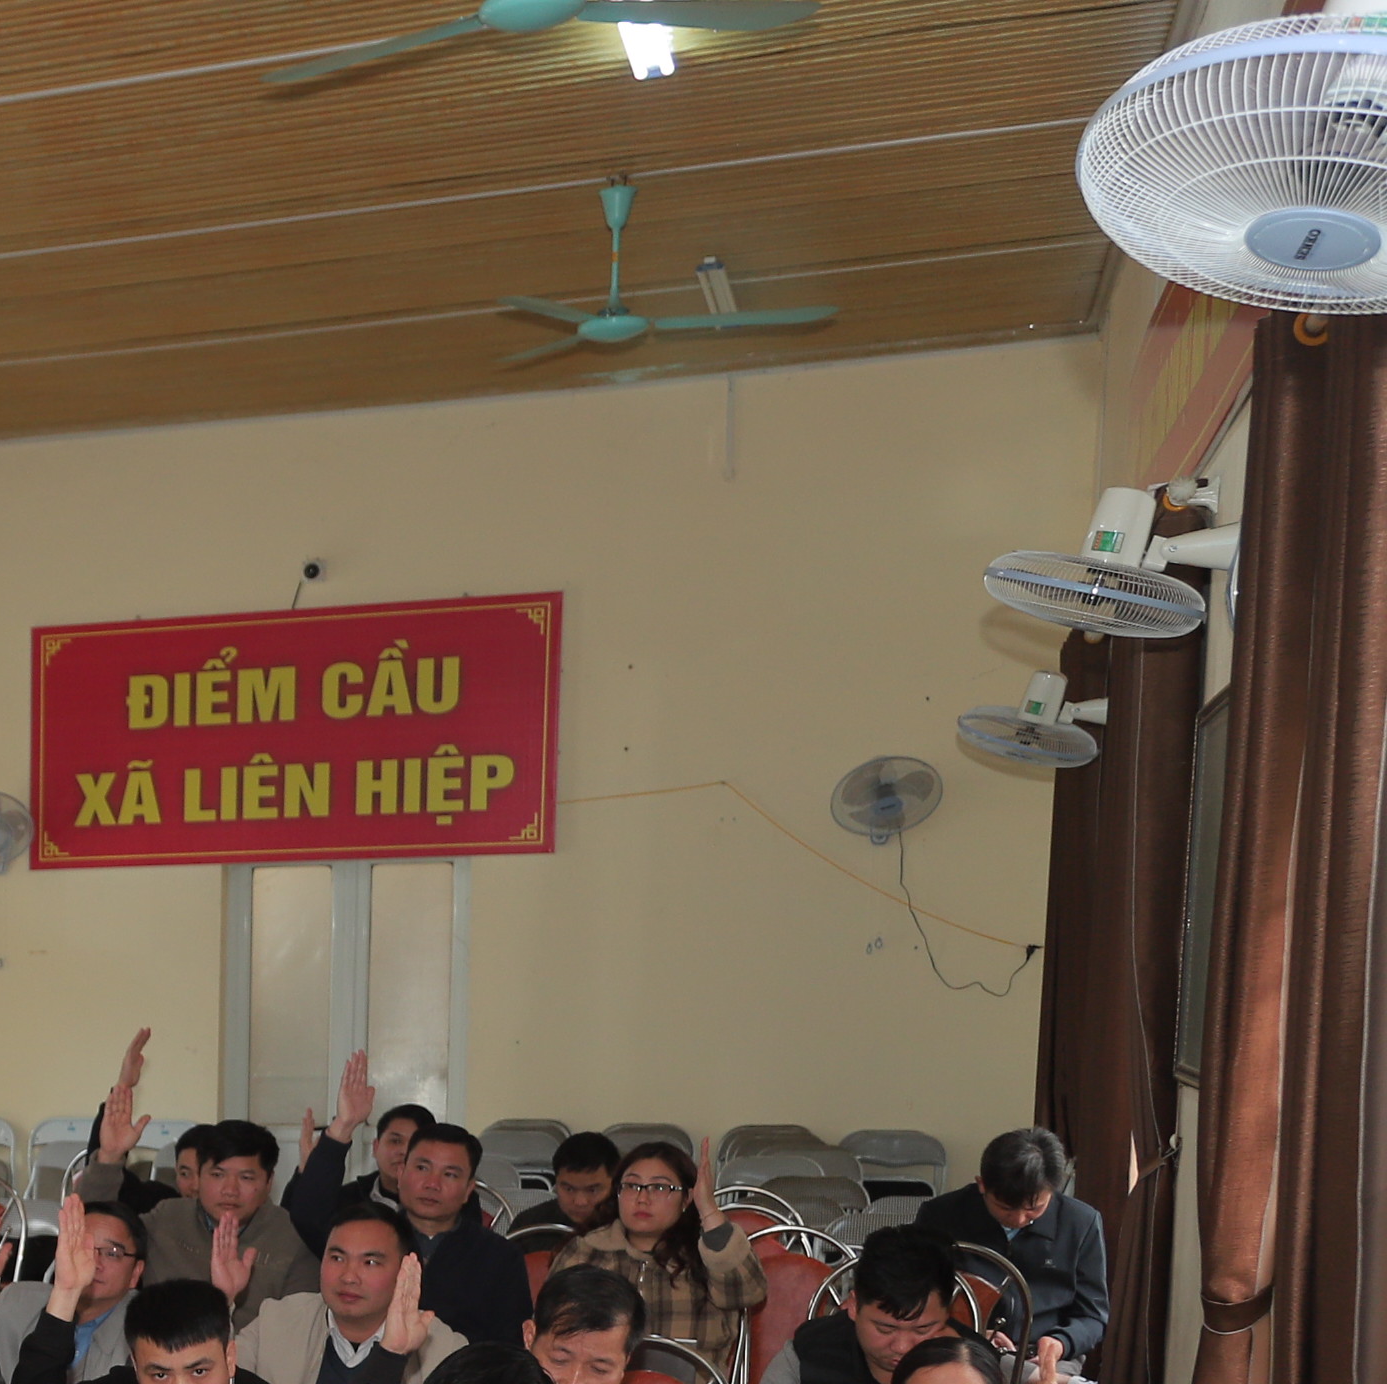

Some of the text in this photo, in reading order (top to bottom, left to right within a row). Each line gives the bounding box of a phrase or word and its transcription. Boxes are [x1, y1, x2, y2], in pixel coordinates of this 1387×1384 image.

[126, 639, 462, 730] ĐIỂM CẦU
[74, 744, 515, 828] XÃ LIÊN HIỆP
